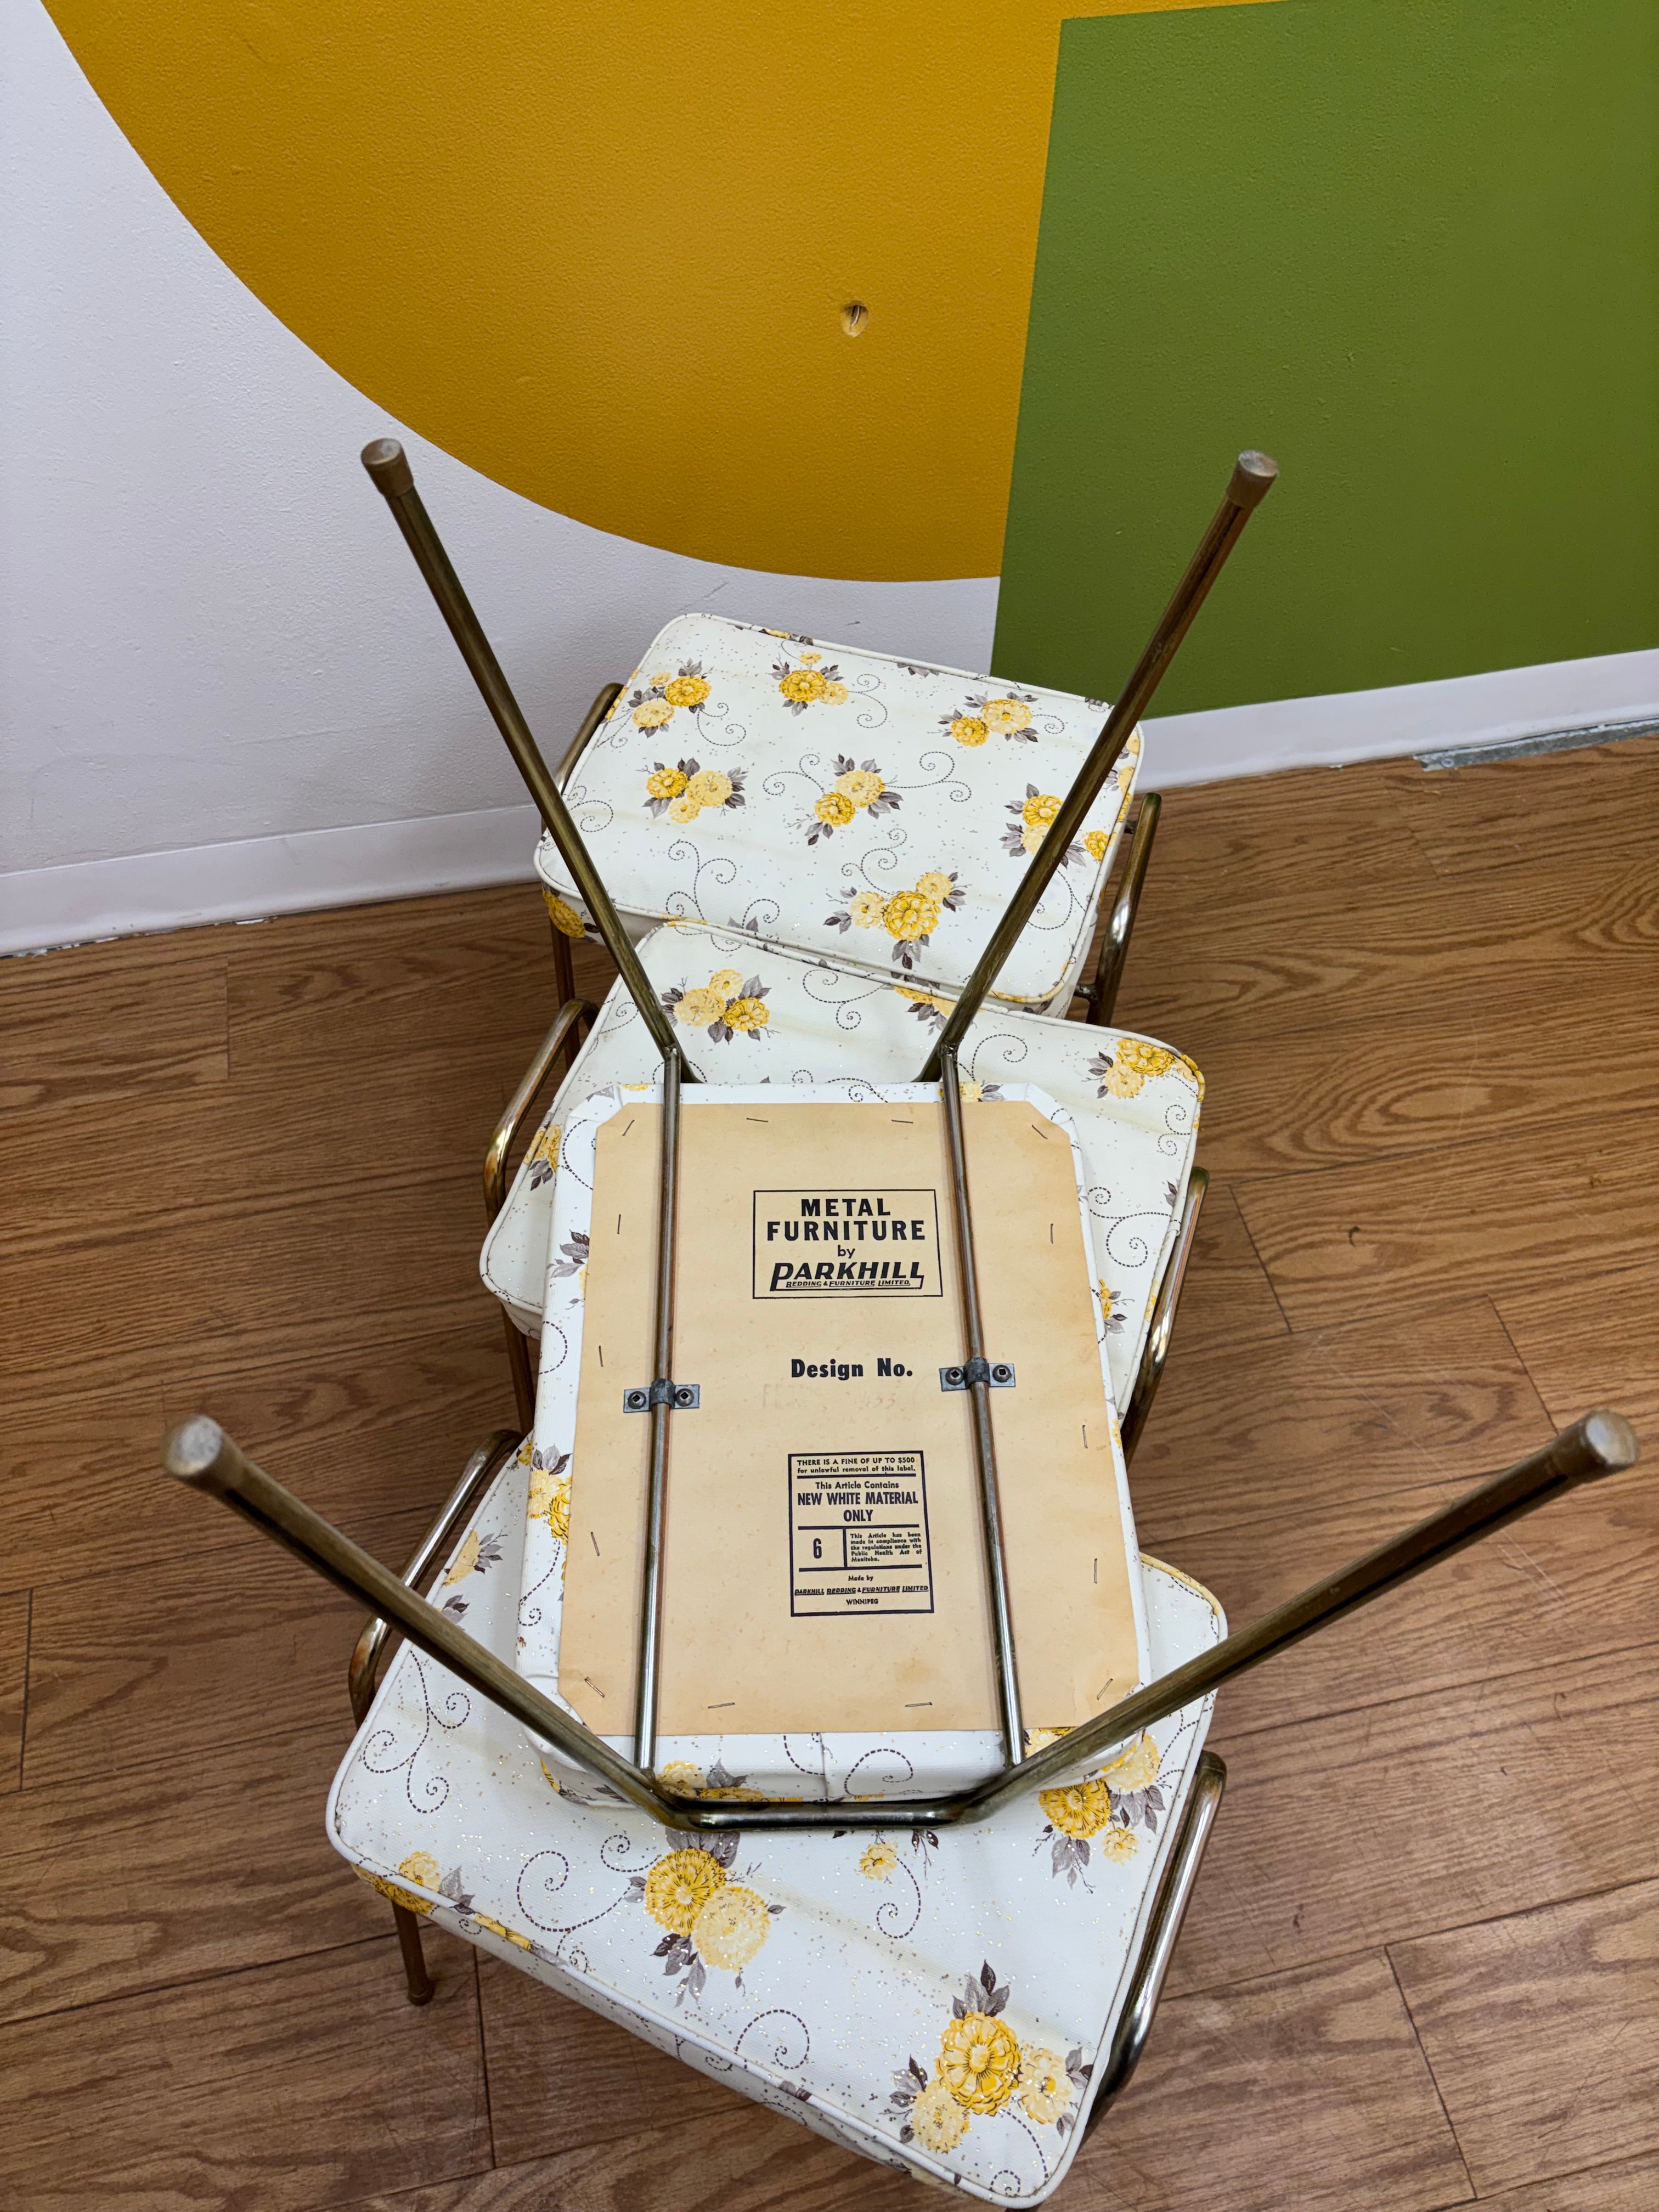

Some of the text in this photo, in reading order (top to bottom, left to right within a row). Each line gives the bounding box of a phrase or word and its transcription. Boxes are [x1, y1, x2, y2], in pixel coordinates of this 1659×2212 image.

[801, 1198, 890, 1216] METAL
[767, 1220, 925, 1241] FURNITURE
[837, 1245, 855, 1258] by
[770, 1262, 924, 1291] PARKHILL
[791, 1358, 913, 1381] Design No.
[798, 1492, 918, 1505] NEW WHITE MATERIAL
[843, 1509, 873, 1521] ONLY
[813, 1538, 822, 1559] 6
